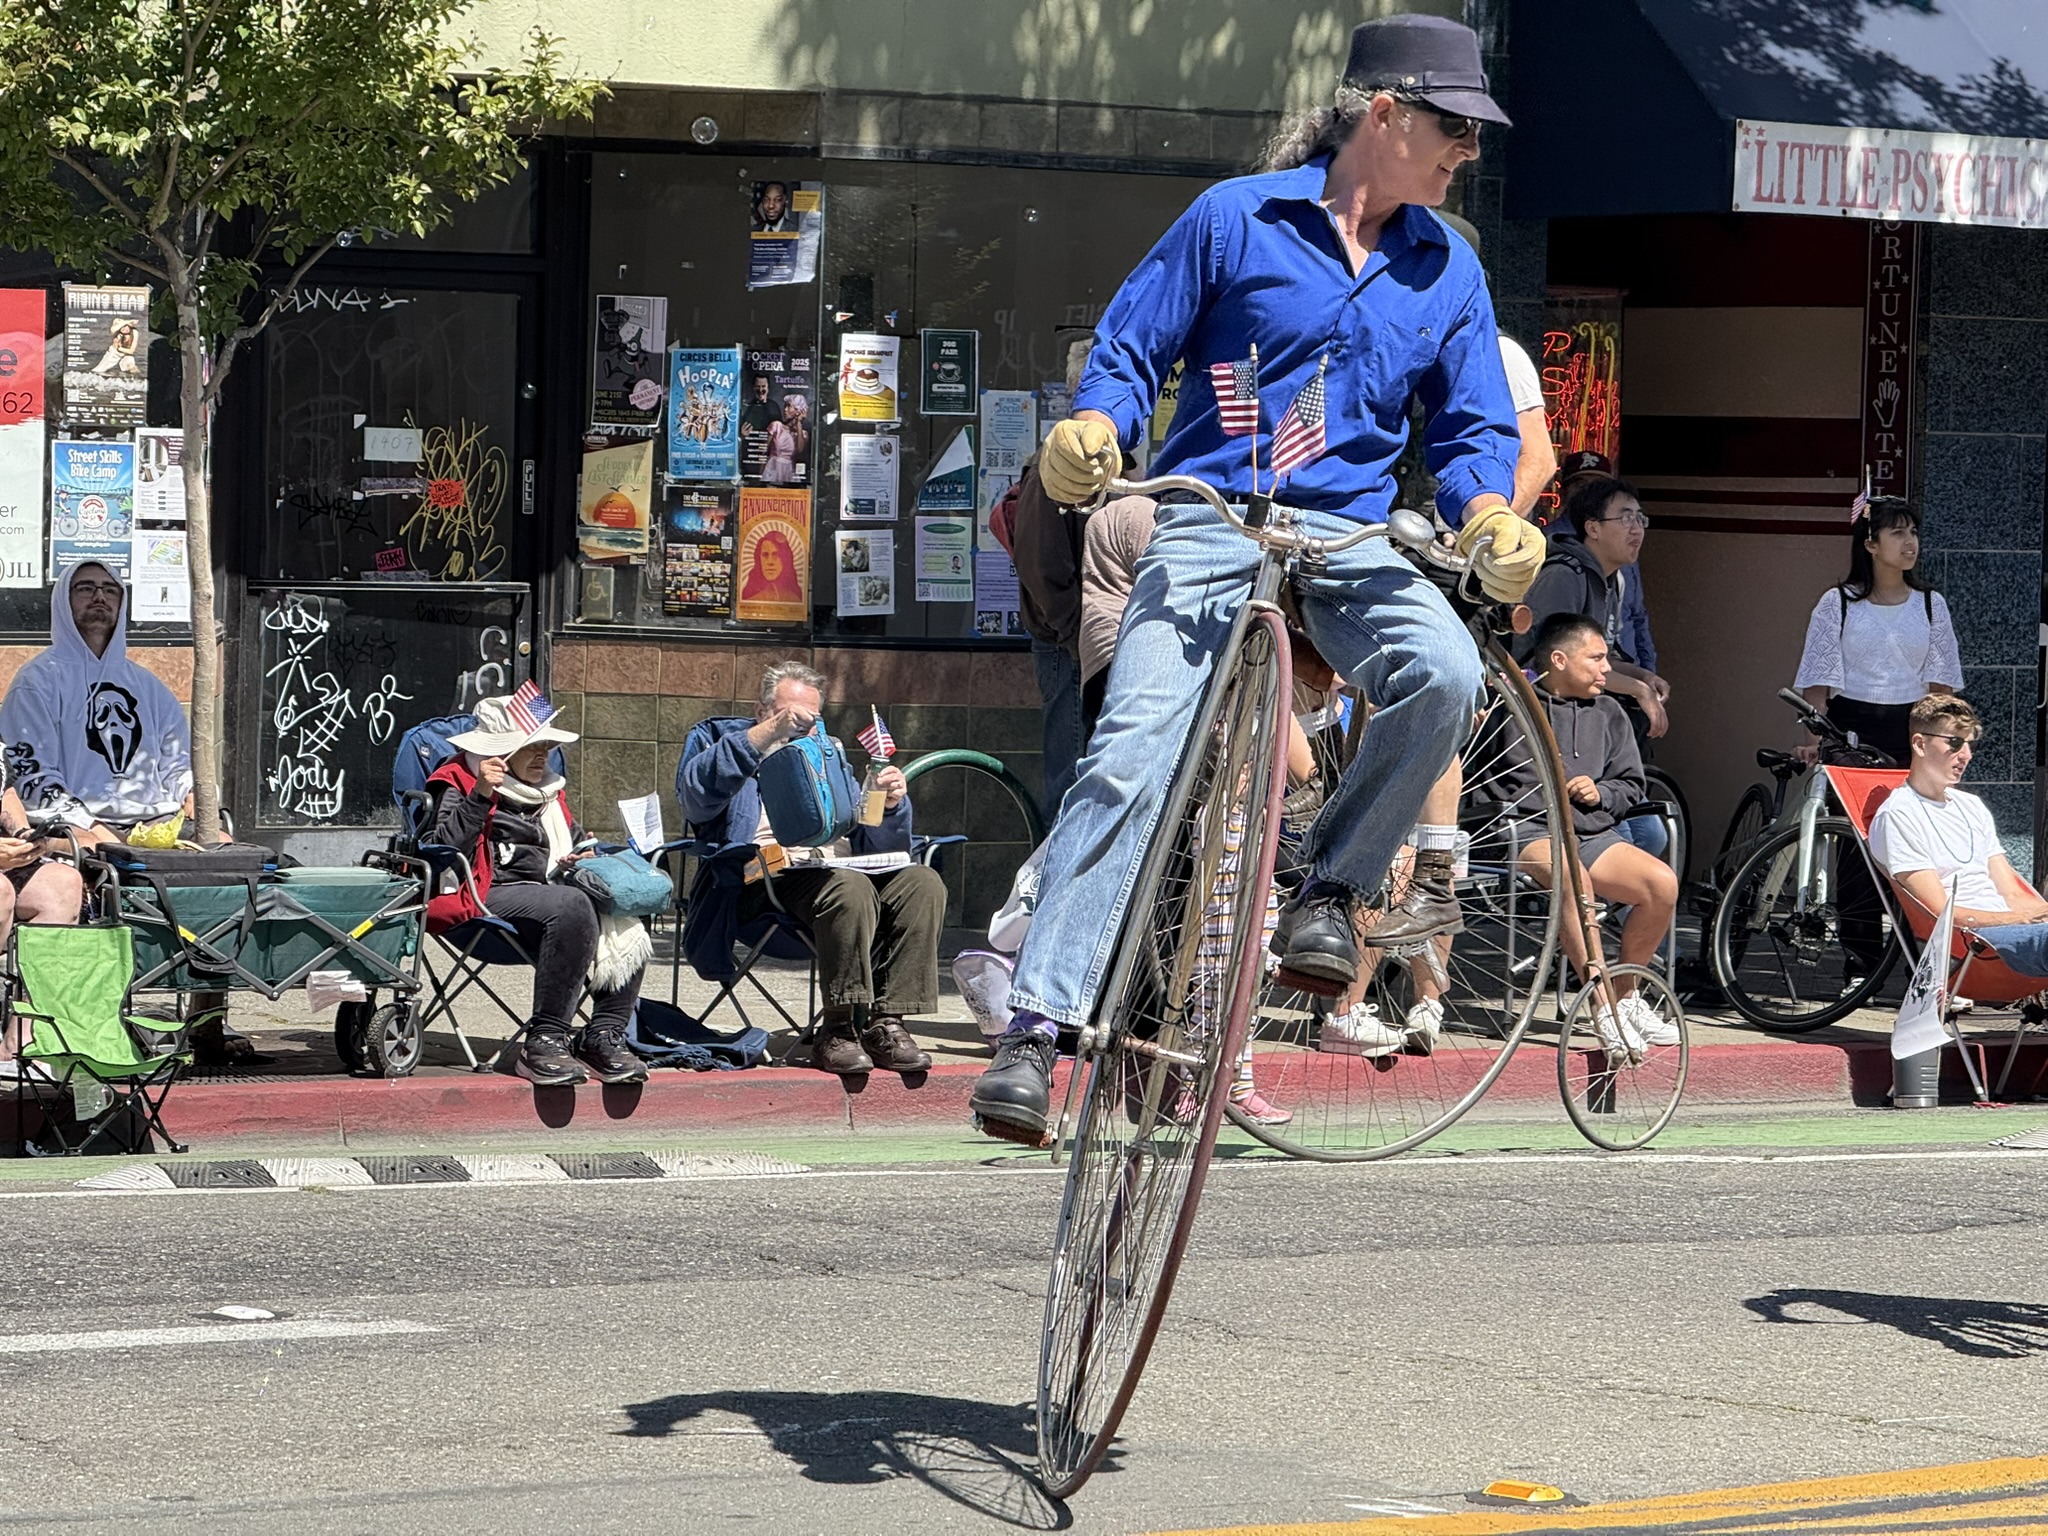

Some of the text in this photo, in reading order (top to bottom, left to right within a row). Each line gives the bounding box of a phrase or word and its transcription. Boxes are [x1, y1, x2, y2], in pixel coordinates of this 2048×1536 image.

[1752, 139, 1880, 210] LITTLE
[68, 292, 145, 309] RISING SEAS
[1877, 221, 1902, 373] RTUNE
[680, 353, 732, 362] CIRCUS BELLA
[747, 352, 785, 361] POCKET
[791, 358, 810, 366] 2025
[752, 361, 784, 371] OPERA
[68, 449, 122, 464] Street Skills
[70, 463, 117, 480] Bike Camp
[524, 464, 533, 501] PULL
[742, 498, 807, 528] ANNUNCIATION
[6, 562, 36, 579] JLL
